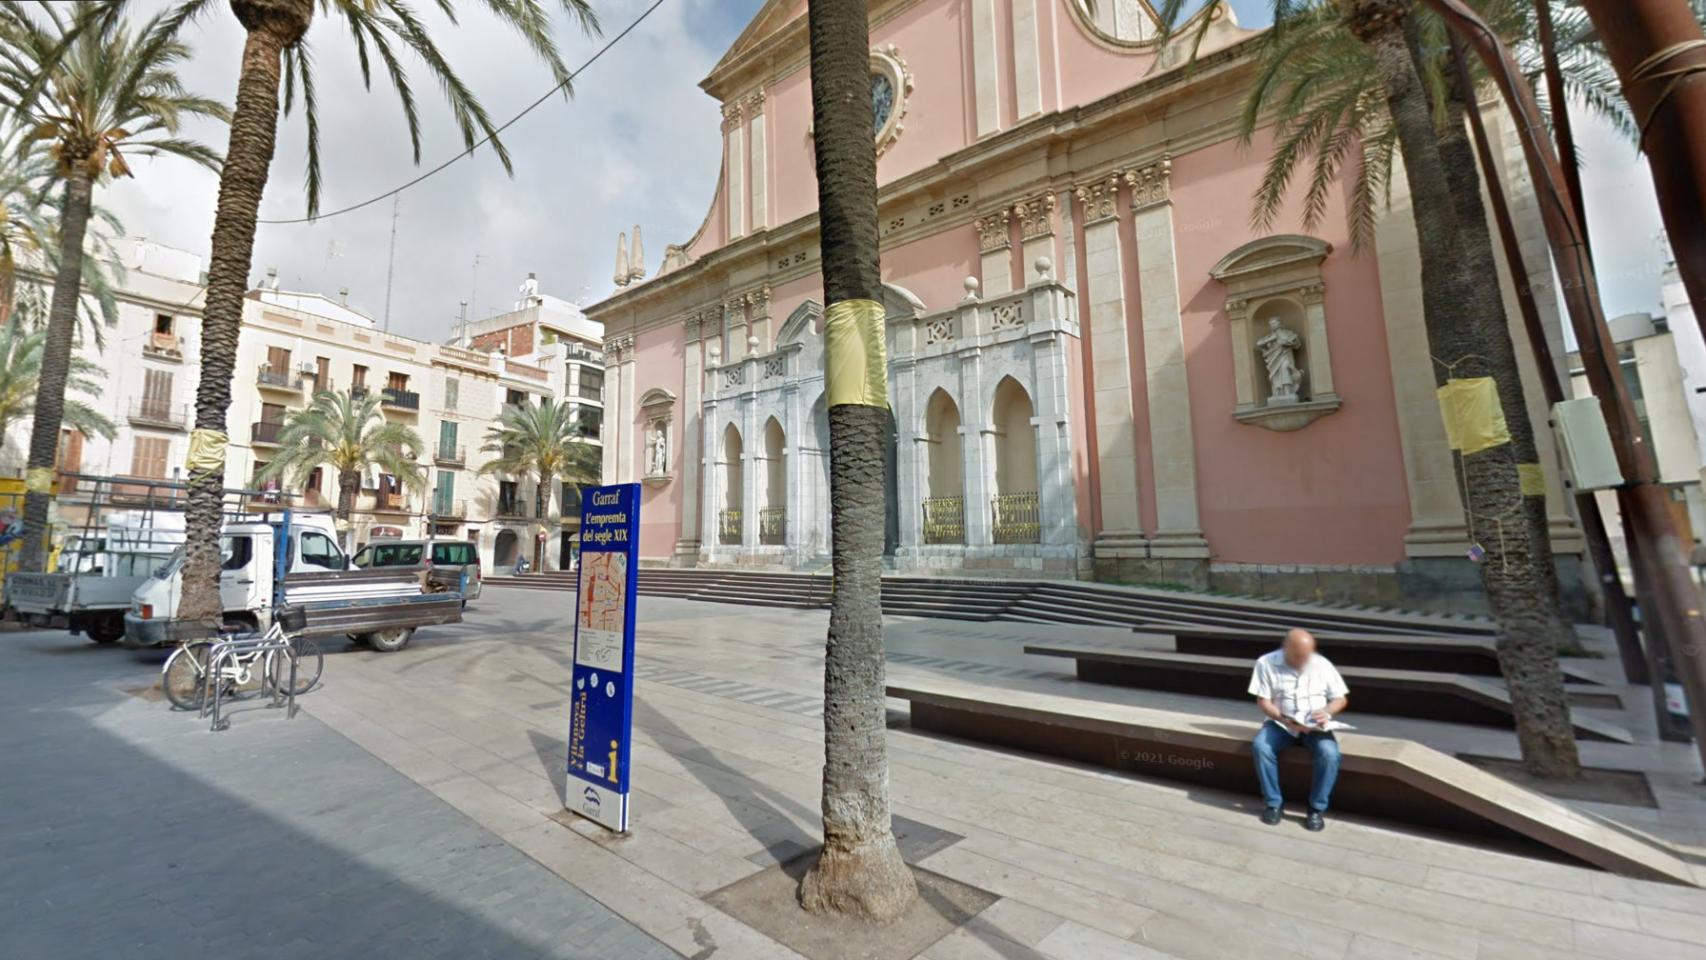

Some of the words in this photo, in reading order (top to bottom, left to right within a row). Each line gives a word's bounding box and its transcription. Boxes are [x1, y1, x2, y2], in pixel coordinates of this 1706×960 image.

[592, 489, 621, 506] Garraf
[585, 512, 627, 528] L'empremta
[583, 529, 594, 542] del
[594, 529, 613, 546] segle
[614, 528, 628, 542] XIX
[570, 702, 580, 766] Vilanova
[577, 746, 584, 759] la
